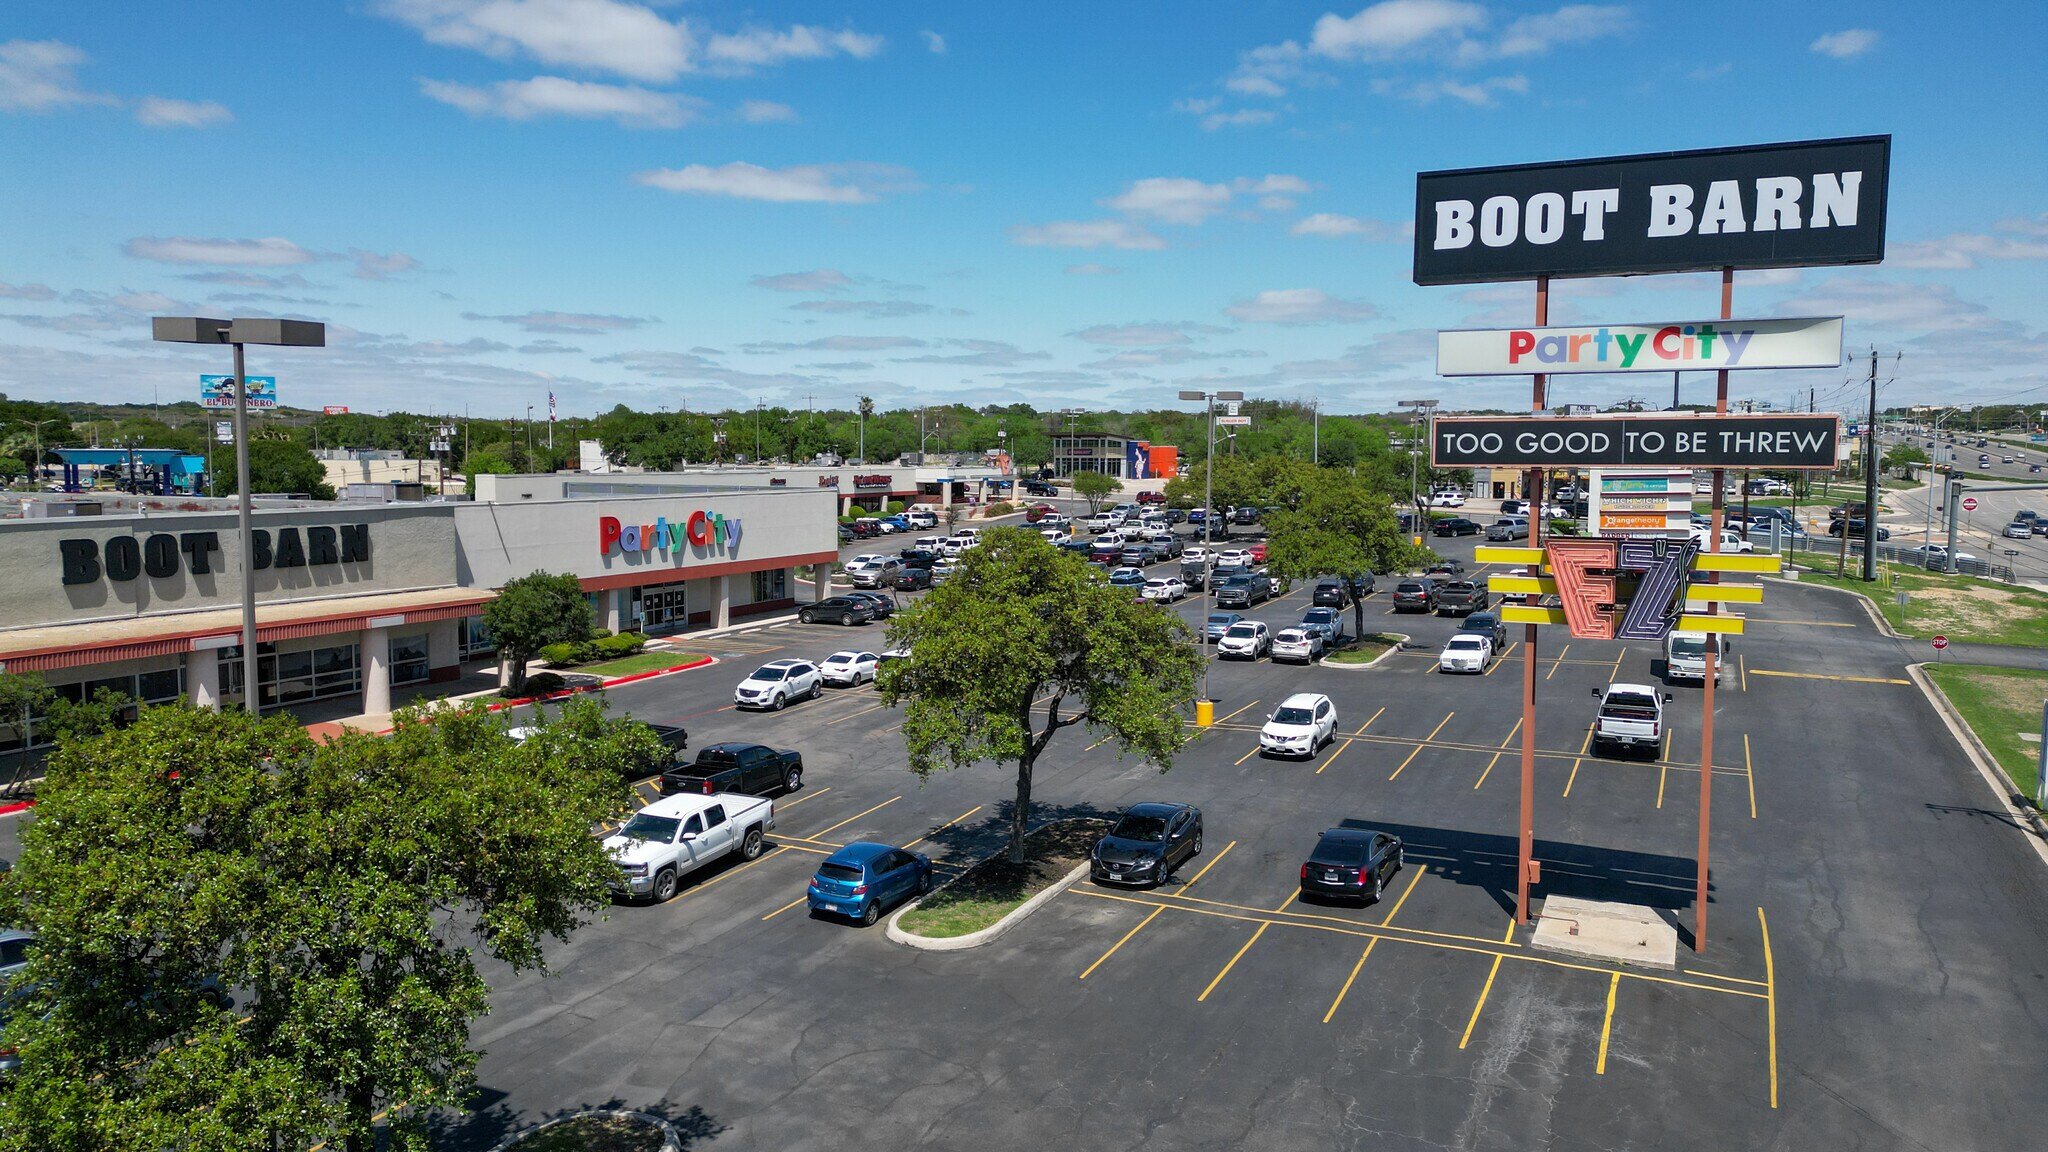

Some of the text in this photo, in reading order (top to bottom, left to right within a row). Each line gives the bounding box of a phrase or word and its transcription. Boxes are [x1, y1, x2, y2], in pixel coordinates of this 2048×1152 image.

[1434, 171, 1863, 250] BOOT BARN
[221, 398, 273, 407] BUNERO
[1443, 431, 1828, 454] TOO GOOD TO BE THREW
[59, 524, 369, 585] BOOT BARN
